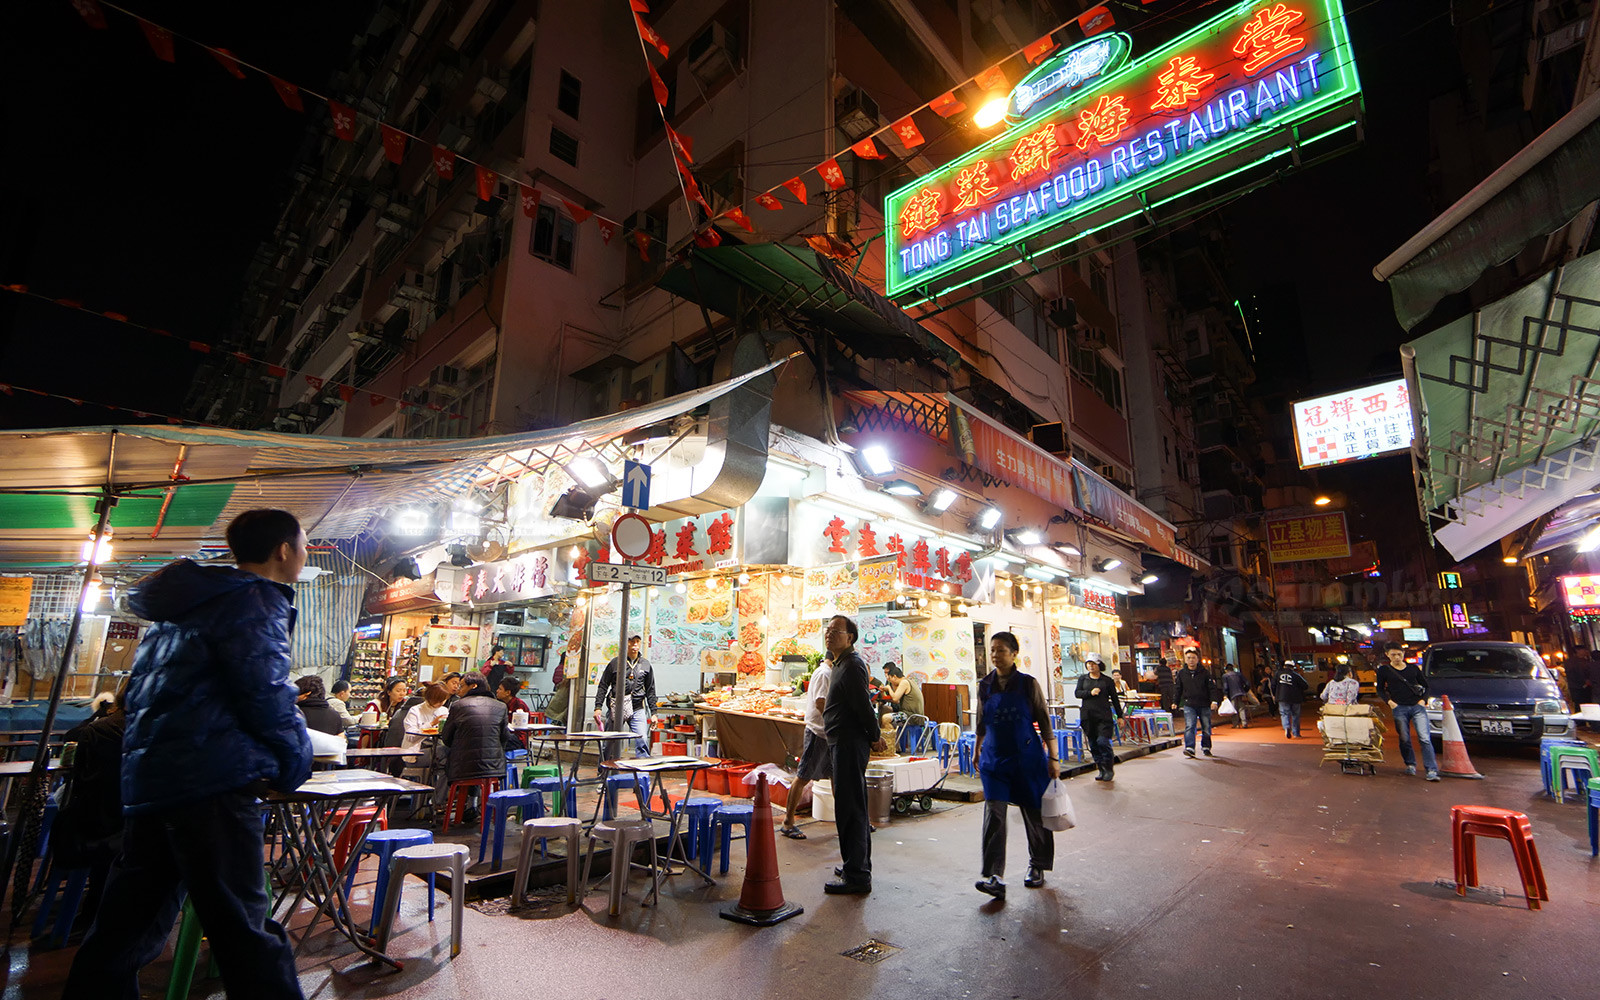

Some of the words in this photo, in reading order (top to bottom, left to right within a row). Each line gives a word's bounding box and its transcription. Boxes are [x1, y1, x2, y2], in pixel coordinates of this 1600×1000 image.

[899, 229, 951, 275] TONG
[956, 210, 990, 251] TAI
[996, 159, 1103, 233] SEAFOOD
[1112, 53, 1321, 182] RESTAURANT
[1270, 516, 1344, 544] 立基物業
[610, 566, 619, 578] 2
[651, 570, 664, 582] 12
